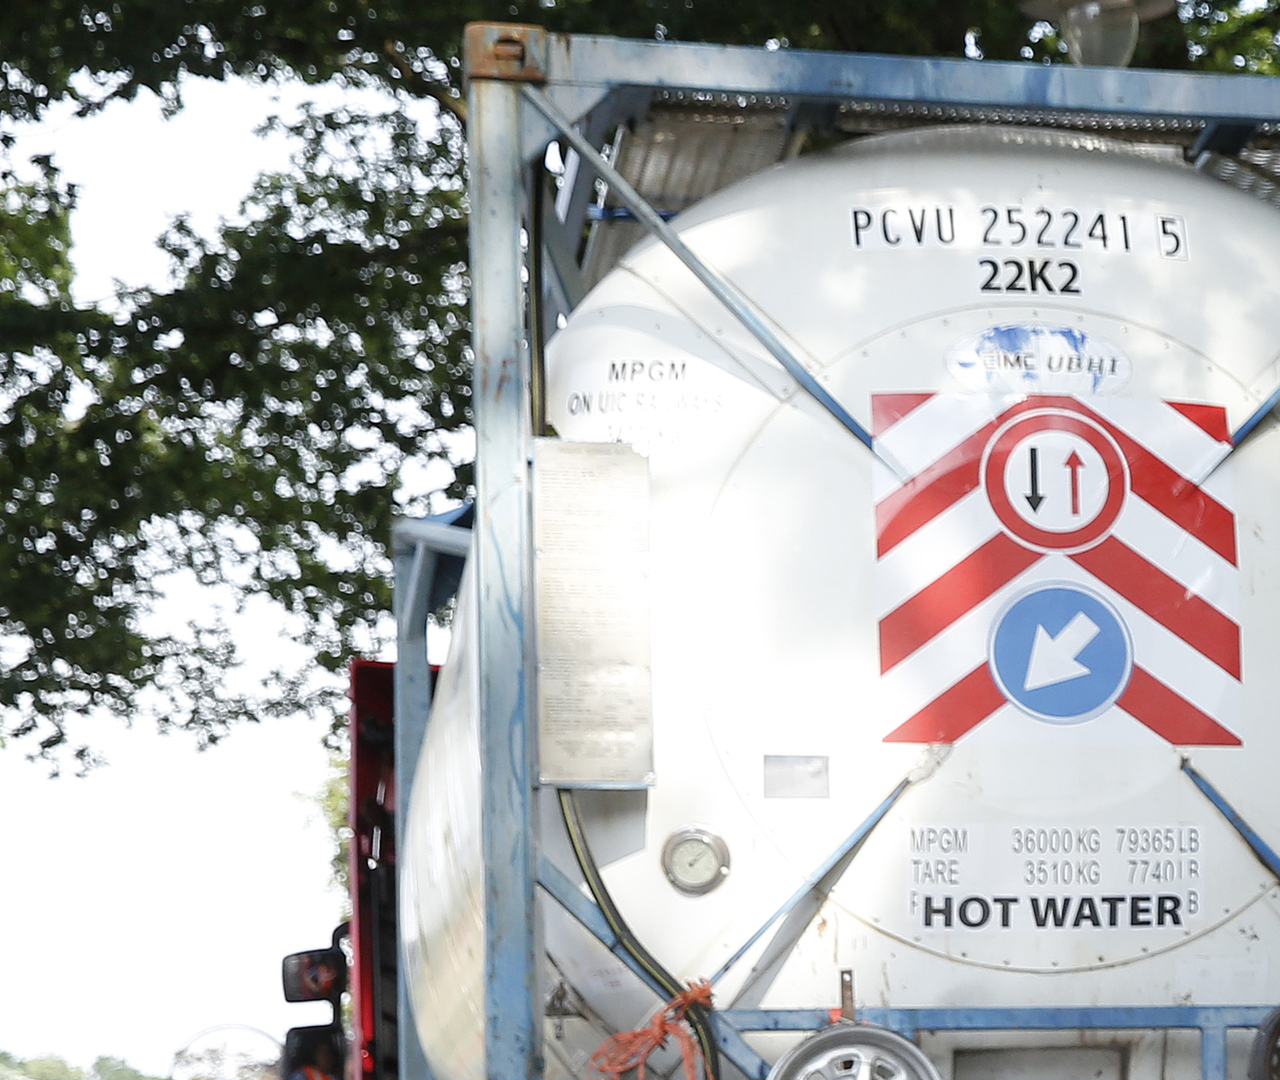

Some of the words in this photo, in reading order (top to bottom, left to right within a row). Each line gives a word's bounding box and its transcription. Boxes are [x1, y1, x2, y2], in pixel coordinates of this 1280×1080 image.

[853, 207, 955, 247] PCVU
[981, 207, 1131, 252] 252241
[1161, 217, 1181, 257] 5
[979, 259, 1083, 294] 22K2
[608, 359, 687, 383] MPGM
[567, 391, 592, 416] ON
[910, 827, 969, 853] MPGM
[1011, 827, 1073, 854] 36000
[1076, 828, 1101, 854] KG
[1116, 828, 1174, 854] 79365
[1178, 828, 1200, 854] LB
[911, 859, 960, 886] TARE
[1023, 859, 1073, 886] 3510
[1076, 860, 1101, 886] KG
[924, 896, 1018, 928] HOT
[1030, 895, 1182, 928] WATER
